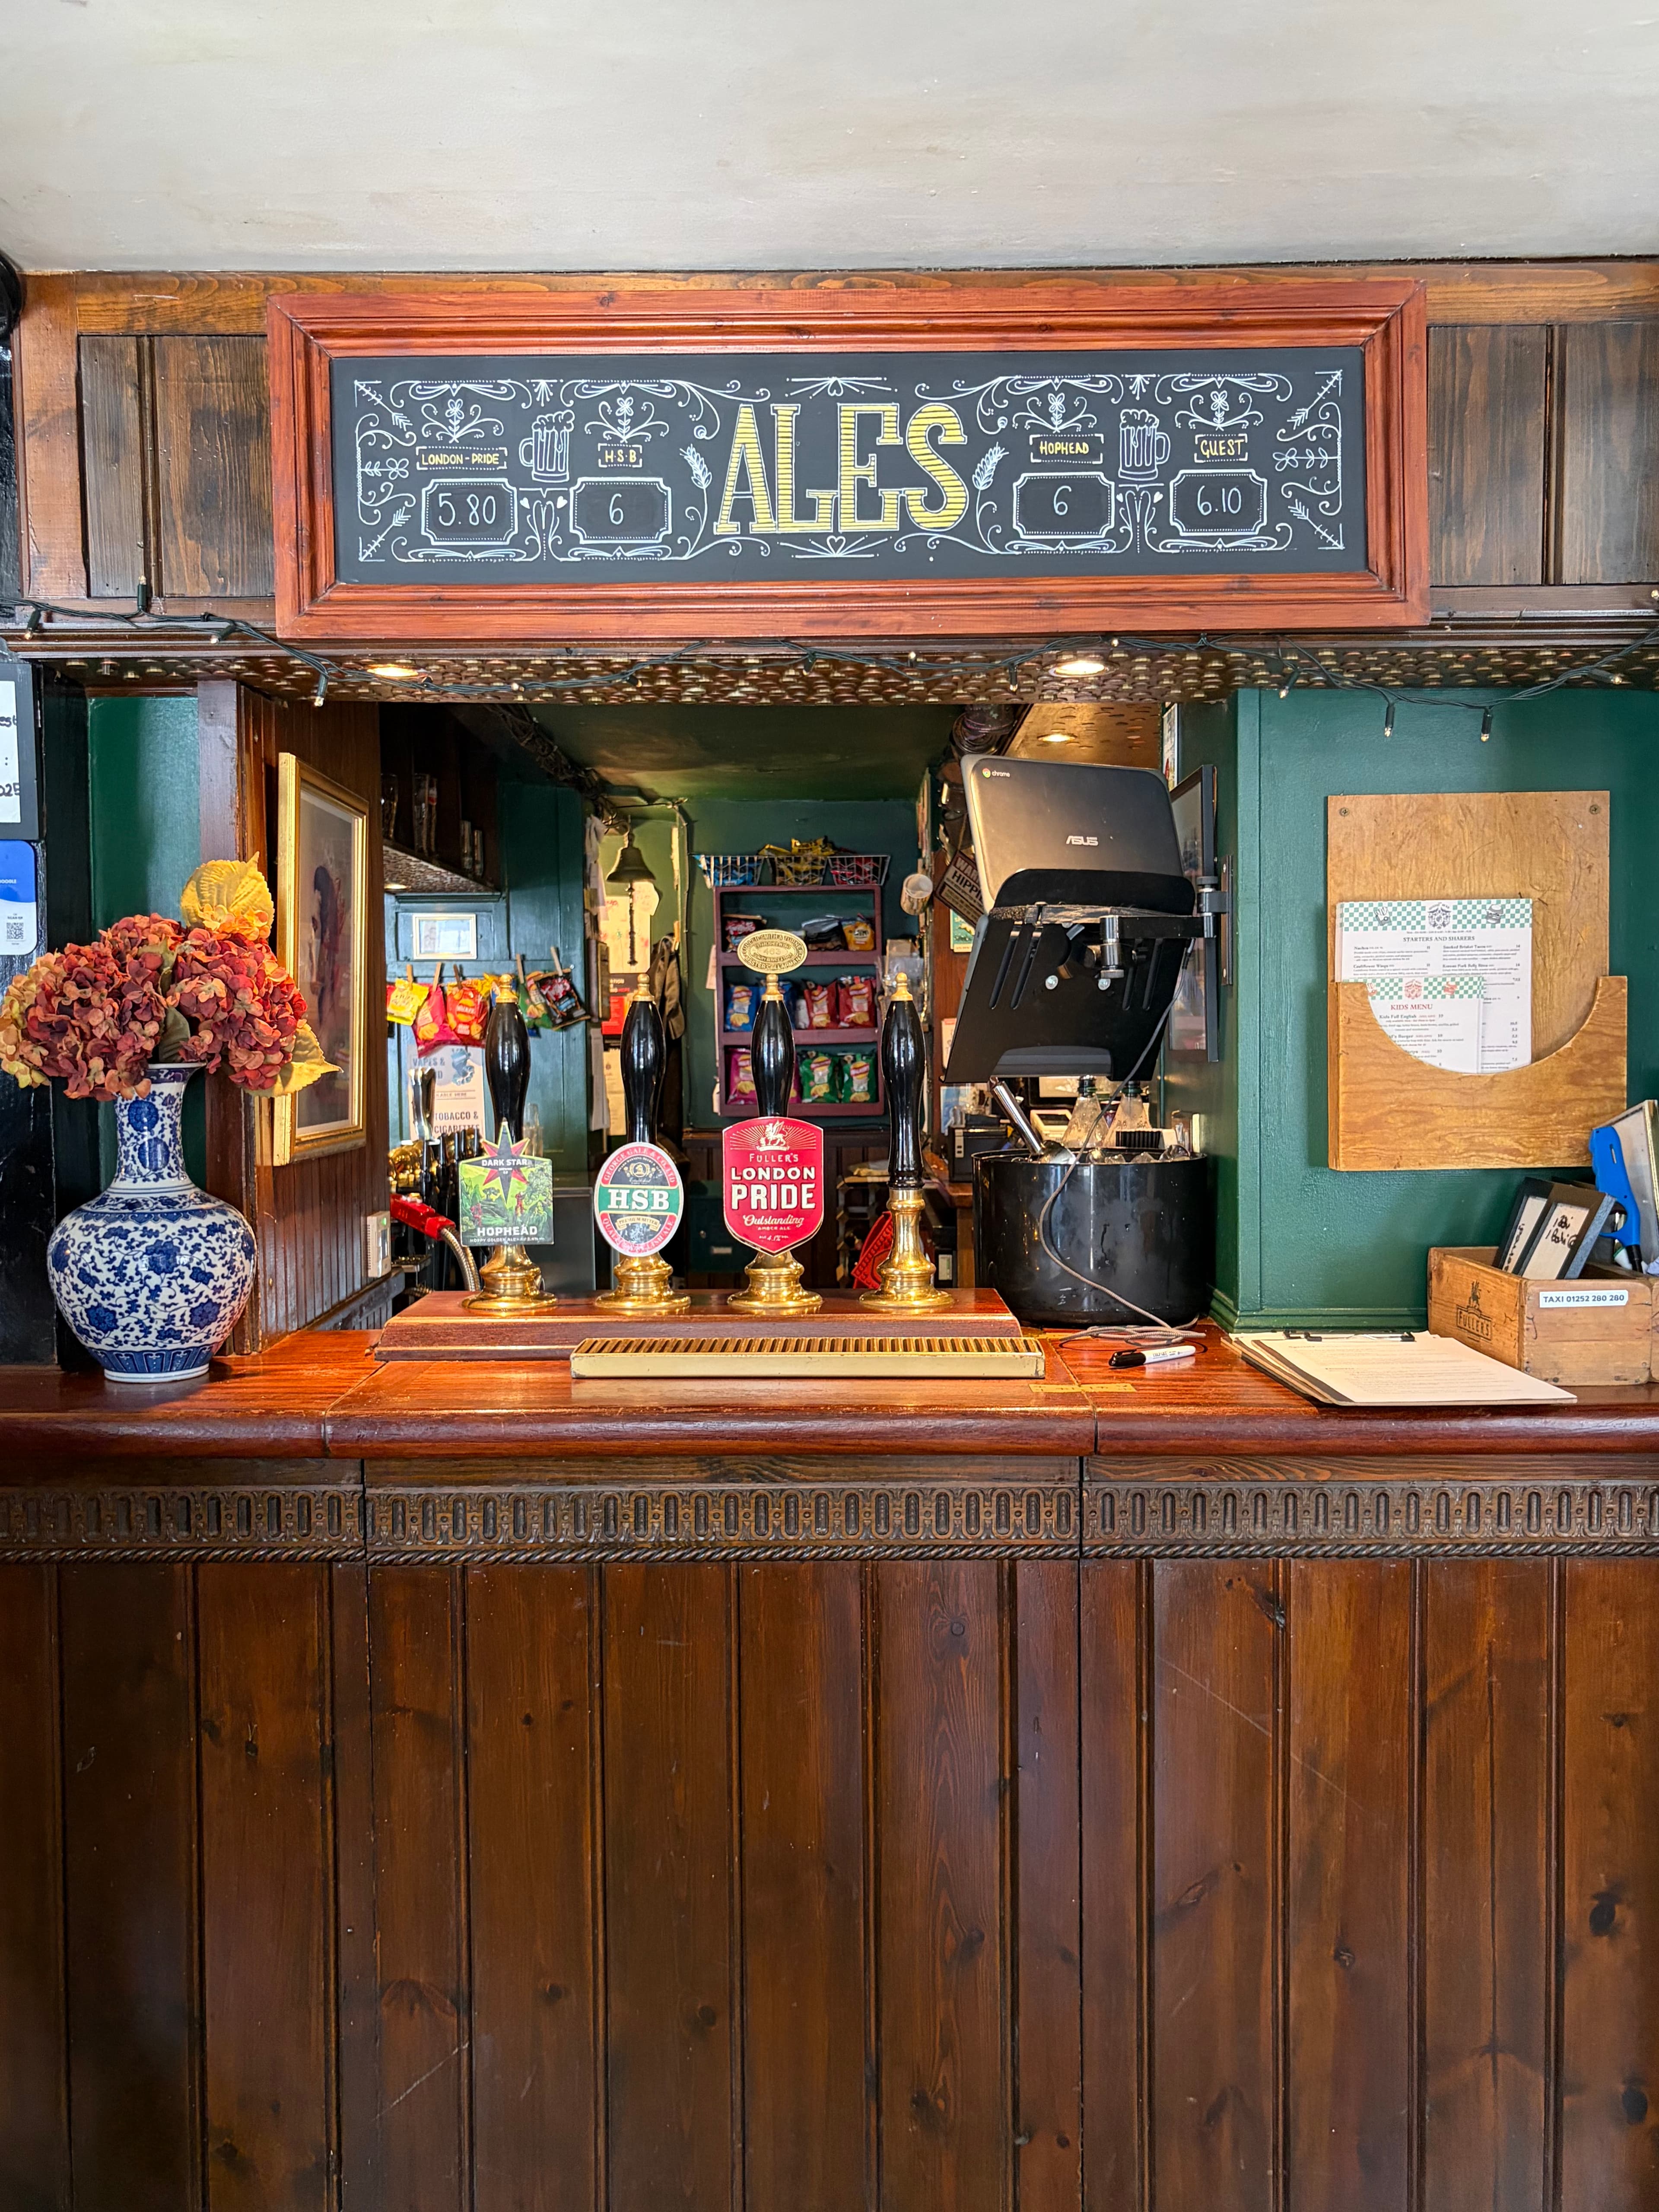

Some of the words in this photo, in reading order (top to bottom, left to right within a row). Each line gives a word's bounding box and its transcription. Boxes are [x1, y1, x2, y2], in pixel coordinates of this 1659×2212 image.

[1039, 440, 1090, 455] HOPHEAD
[1200, 439, 1246, 458] GUEST
[713, 402, 969, 535] ALES
[609, 493, 624, 525] 6
[1054, 485, 1072, 516] 6
[1198, 485, 1242, 515] 6.10
[1066, 836, 1098, 846] ASUS
[435, 1112, 470, 1120] TOBACCO
[604, 1152, 627, 1181] GEORGE
[627, 1147, 649, 1155] GALE
[749, 1153, 799, 1163] FULLER'S
[731, 1166, 816, 1181] LONDON
[607, 1189, 670, 1211] HSB
[731, 1183, 816, 1210] PRIDE
[477, 1224, 538, 1237] HOPHEAD
[743, 1214, 805, 1228] Outstanding
